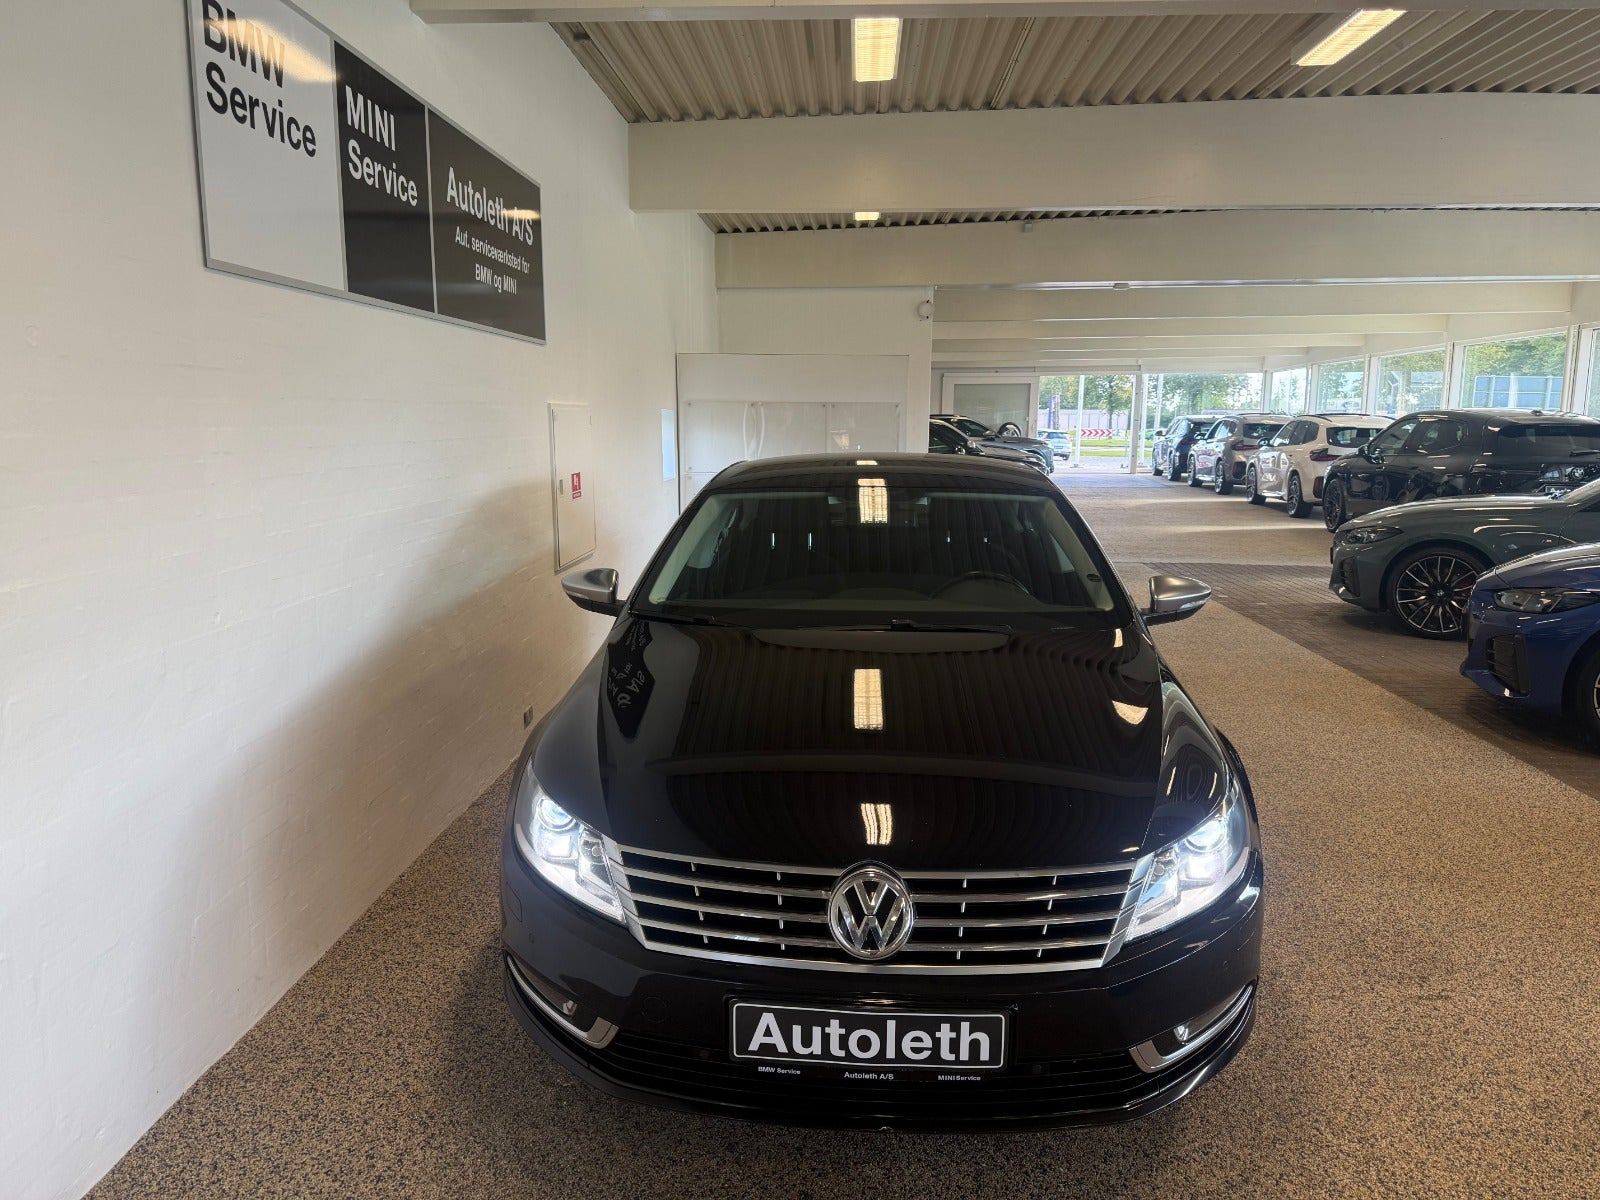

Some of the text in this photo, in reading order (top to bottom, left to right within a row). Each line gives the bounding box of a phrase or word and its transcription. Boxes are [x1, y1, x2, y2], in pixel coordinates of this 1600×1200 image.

[202, 0, 285, 88] BMW
[206, 62, 316, 157] Service
[345, 85, 396, 151] MINI
[348, 139, 418, 206] Service
[447, 166, 533, 246] Autoleth A/S
[455, 226, 470, 248] Aut.
[521, 257, 530, 274] for
[475, 263, 517, 295] BMW og MINI
[747, 1012, 990, 1062] Autoleth
[776, 1067, 801, 1075] Service
[843, 1071, 878, 1080] Autoleth
